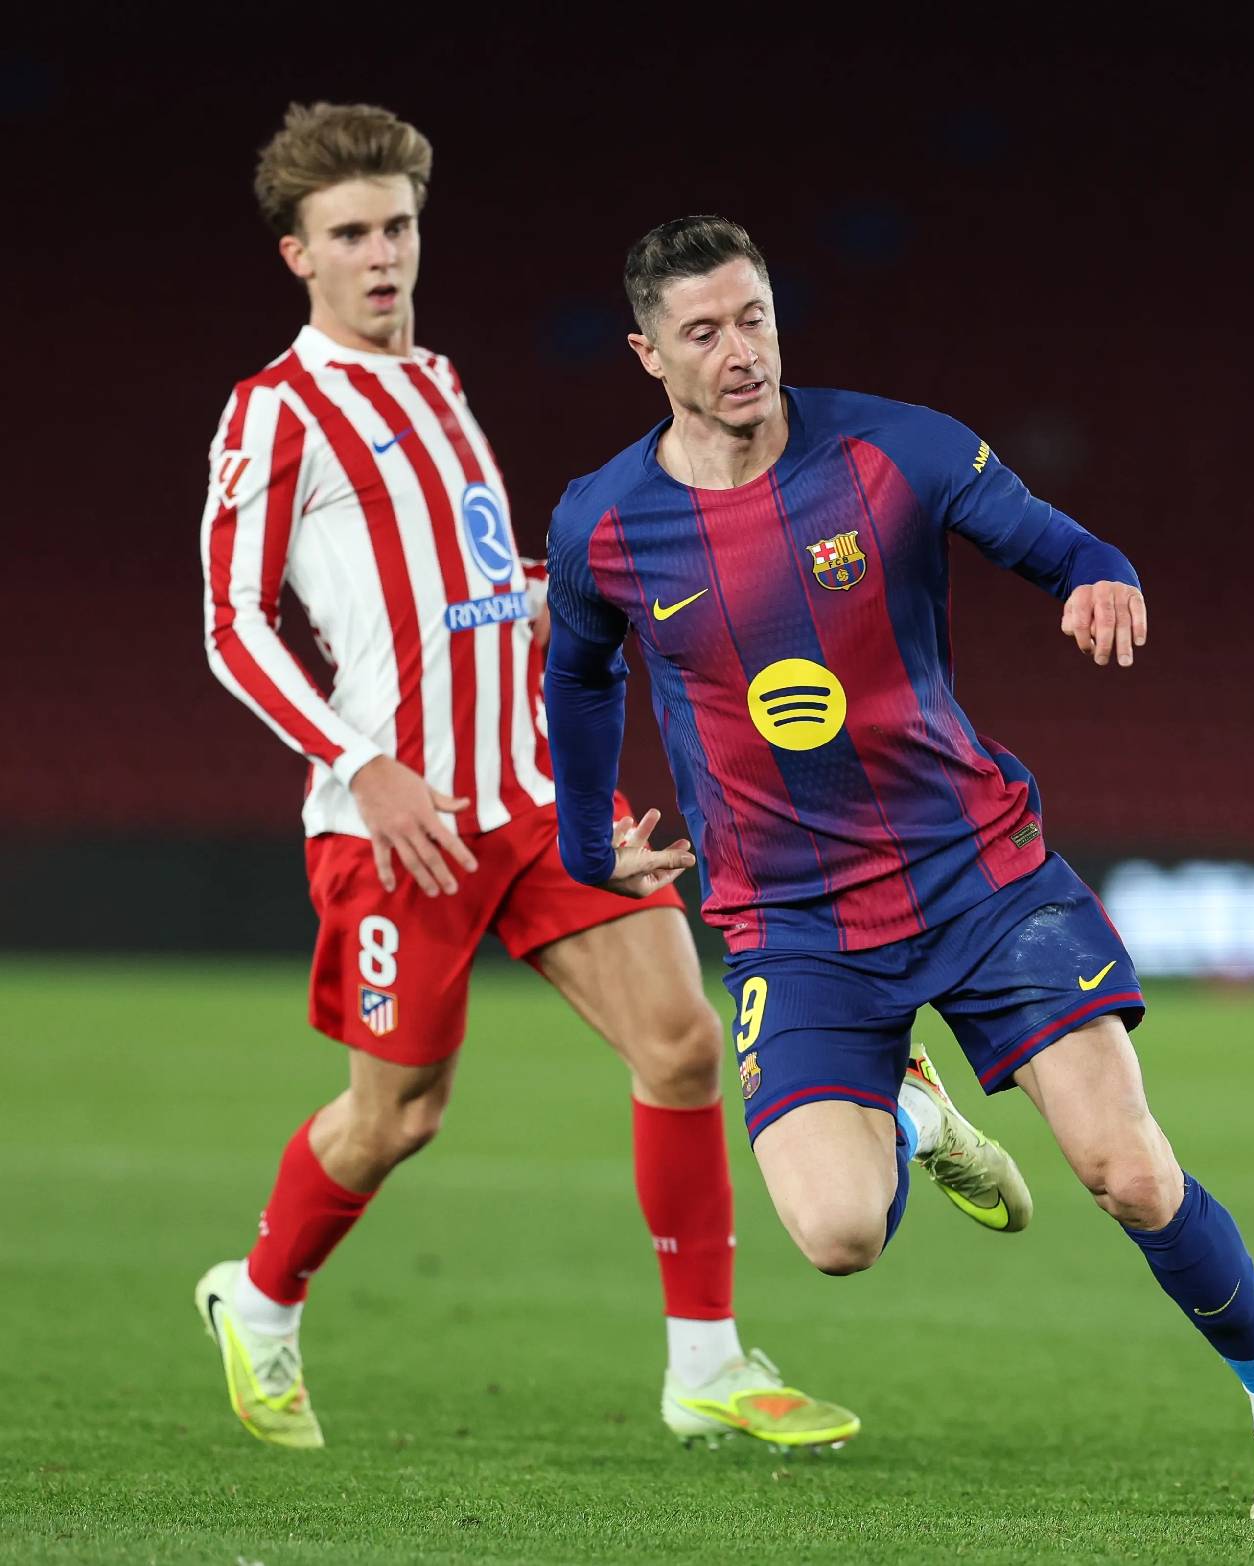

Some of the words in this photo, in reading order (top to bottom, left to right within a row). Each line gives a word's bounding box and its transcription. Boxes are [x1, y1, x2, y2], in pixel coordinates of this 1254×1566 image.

[828, 556, 849, 568] FCB
[359, 915, 399, 988] 8
[737, 976, 768, 1053] 9
